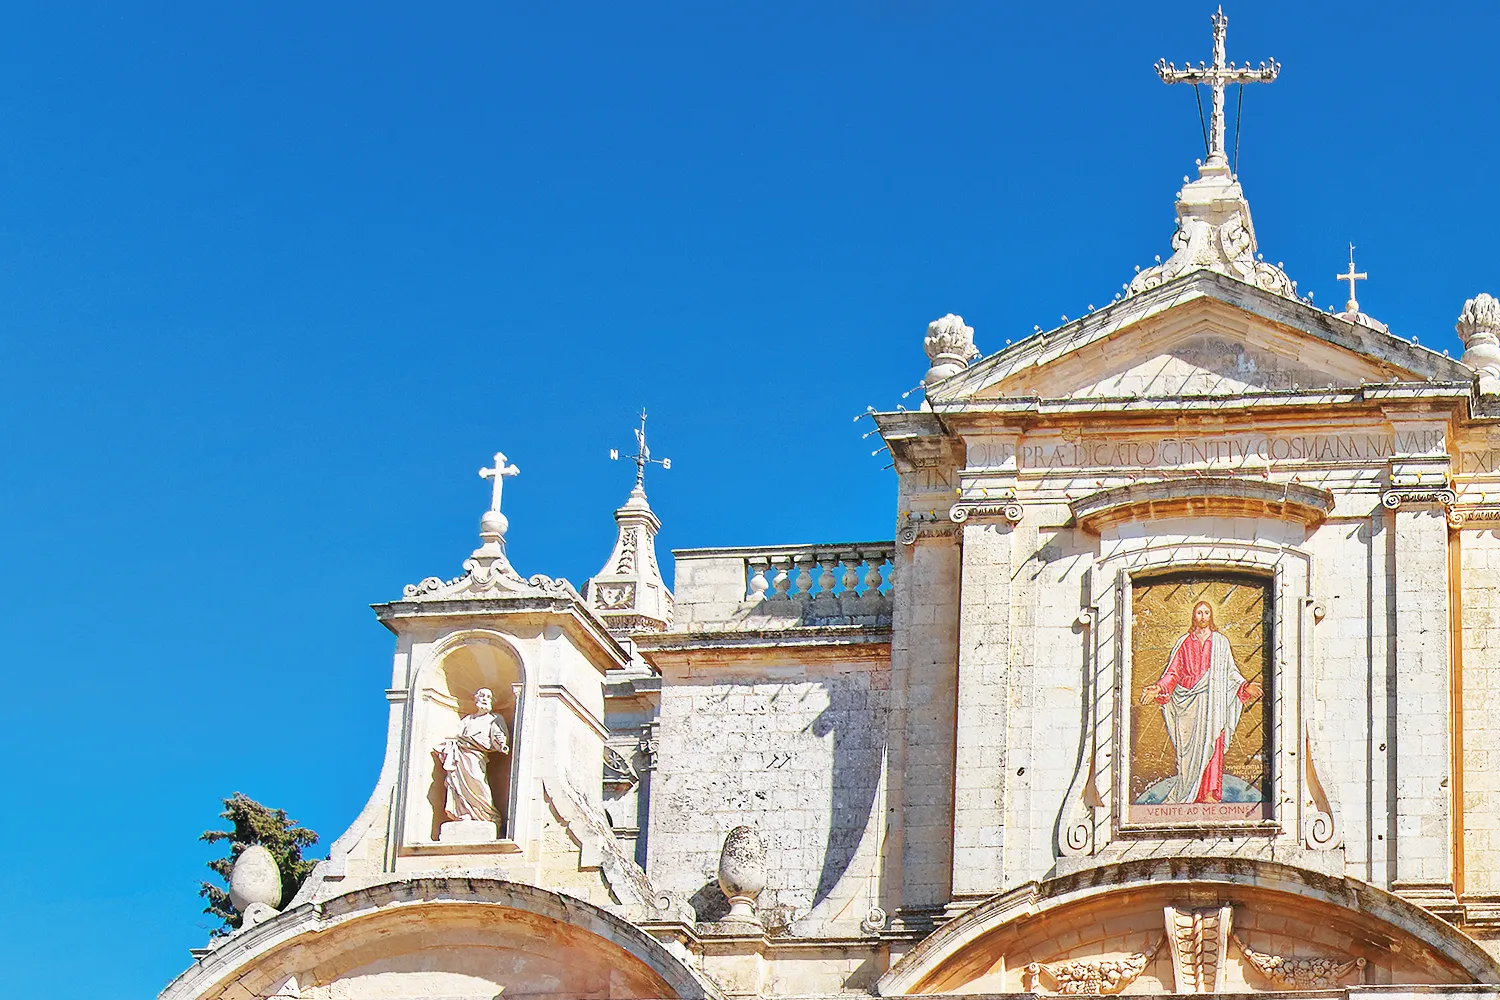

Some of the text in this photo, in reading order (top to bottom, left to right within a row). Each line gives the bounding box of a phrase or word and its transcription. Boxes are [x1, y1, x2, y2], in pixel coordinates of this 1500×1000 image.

[1147, 807, 1184, 817] VENITE
[1187, 806, 1199, 816] AD
[1202, 806, 1216, 816] ME
